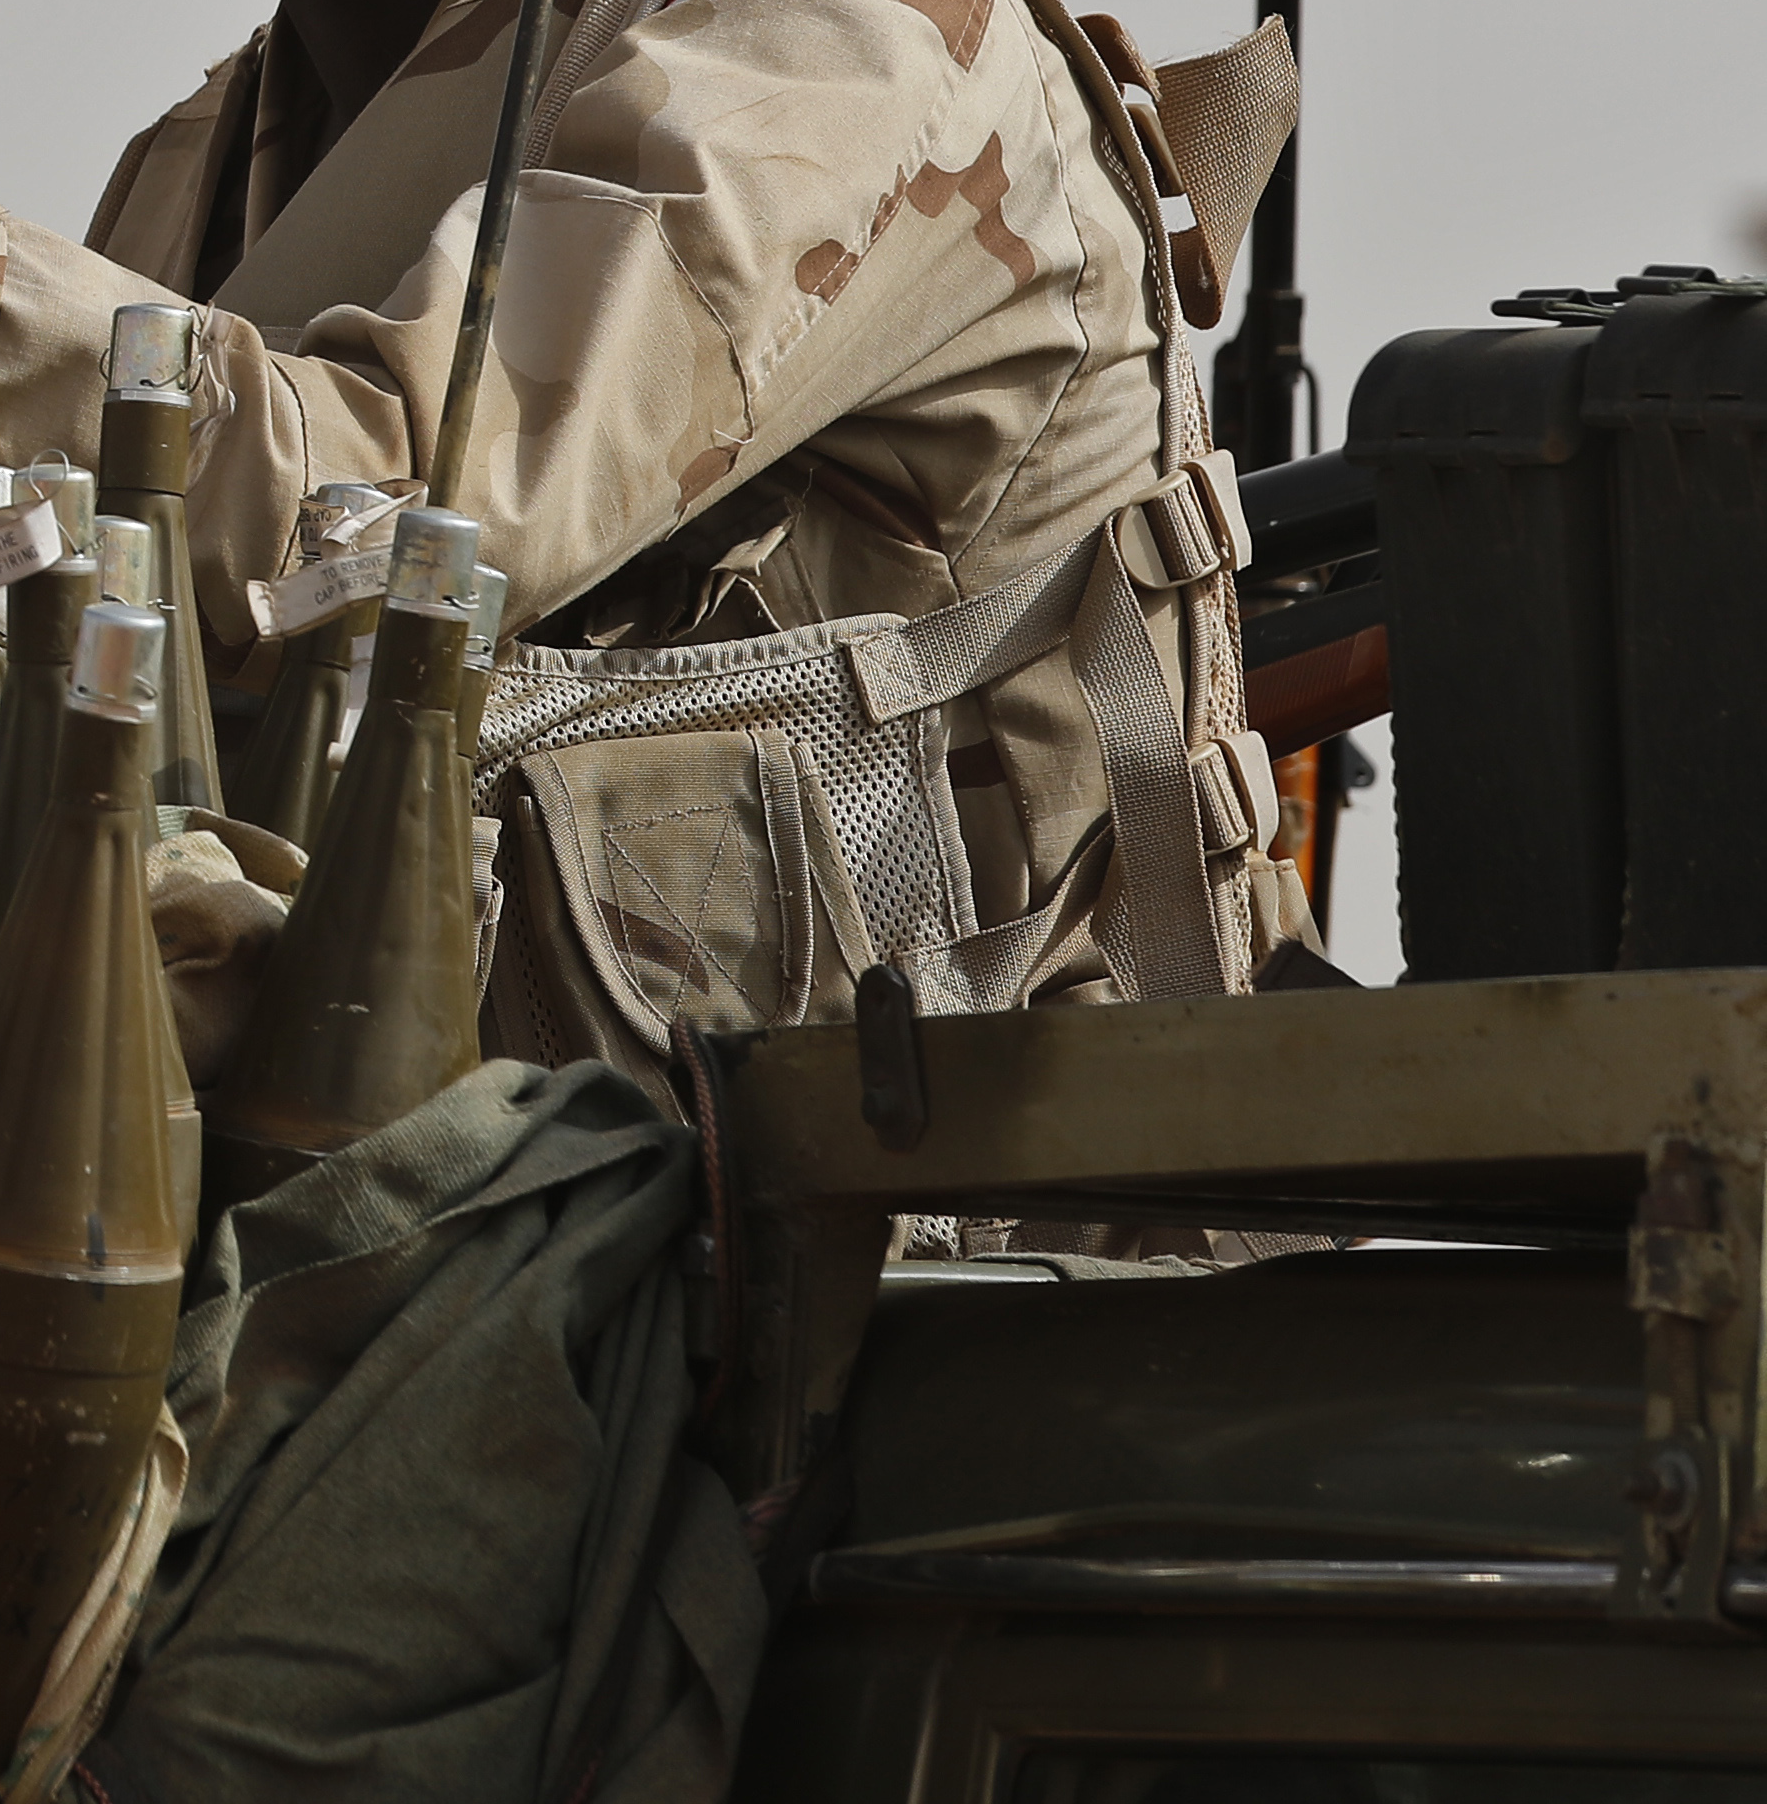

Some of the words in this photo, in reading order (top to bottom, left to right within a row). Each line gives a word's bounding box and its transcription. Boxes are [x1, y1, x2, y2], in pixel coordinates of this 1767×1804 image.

[321, 565, 337, 581] TO
[340, 554, 385, 574] REMOVE
[314, 584, 335, 605] CAP
[338, 573, 383, 592] BEFORE
